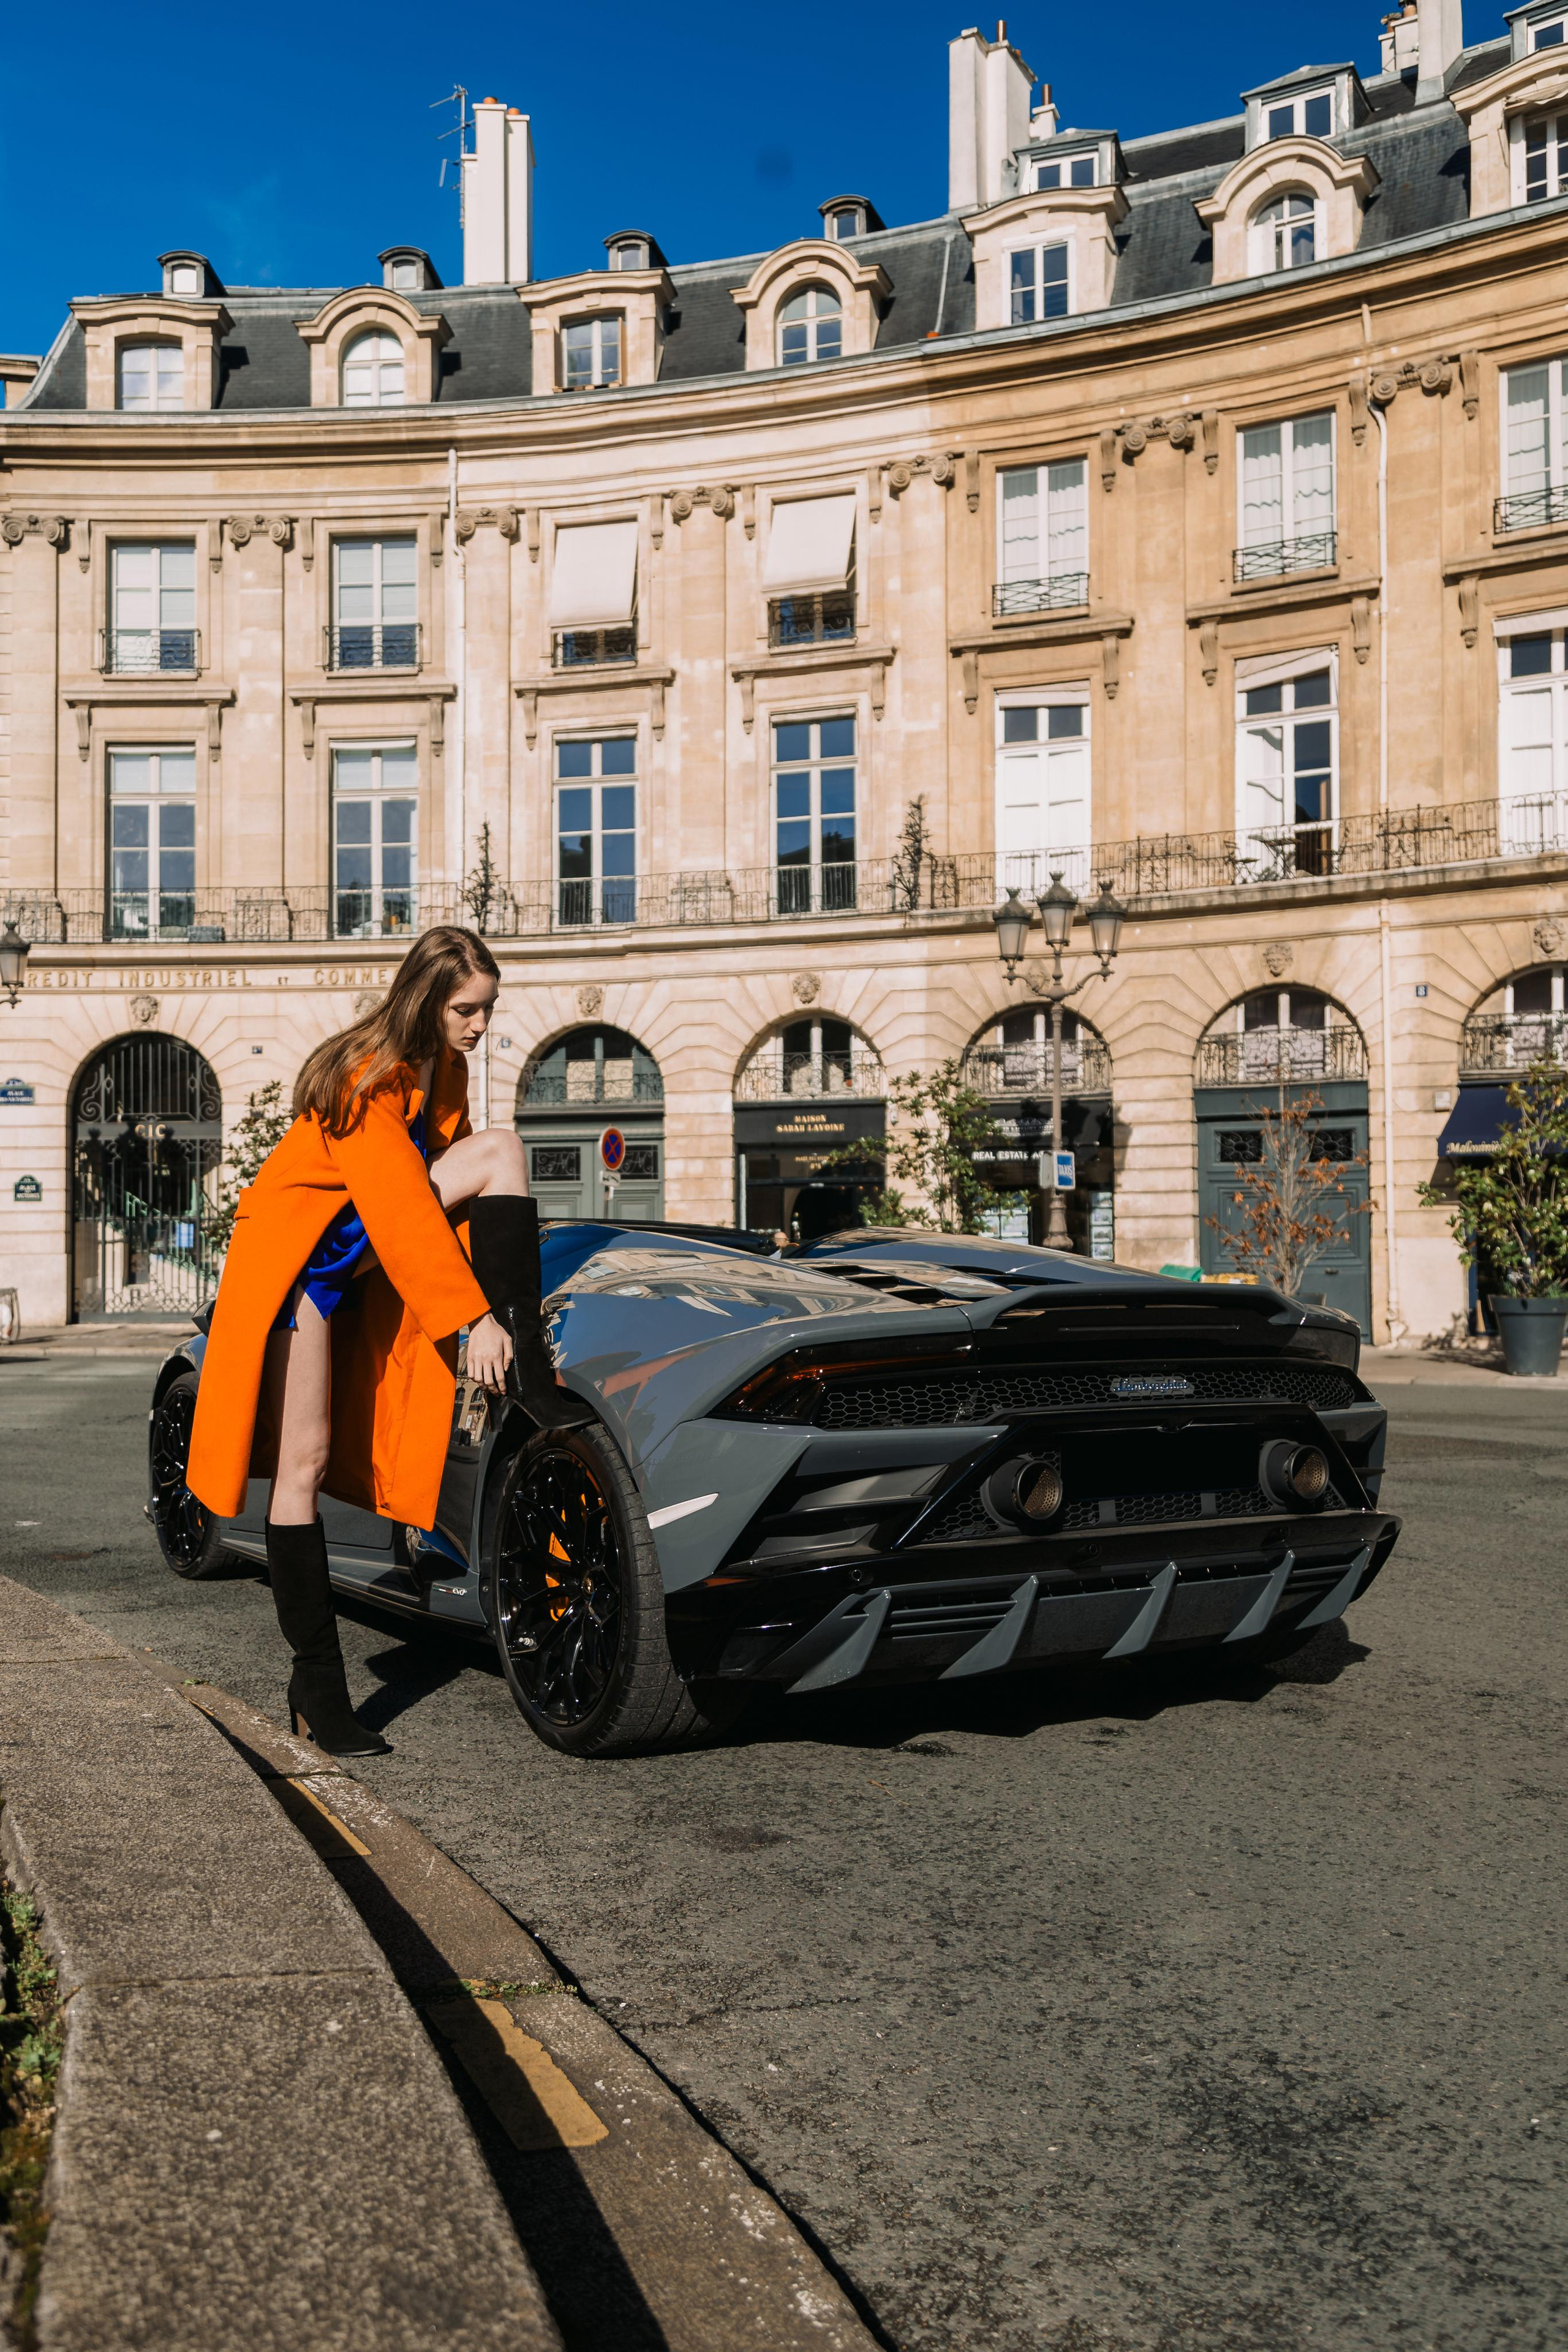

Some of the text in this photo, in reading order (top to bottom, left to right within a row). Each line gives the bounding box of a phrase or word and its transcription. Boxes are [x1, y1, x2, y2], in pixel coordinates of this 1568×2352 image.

[27, 971, 92, 987] REDIT
[119, 969, 252, 987] INDUSTRIEL
[314, 967, 398, 984] COMME
[794, 1114, 826, 1123] MAISON
[135, 1124, 166, 1139] CIC
[776, 1123, 845, 1133] SARAH LAVOINE
[972, 1152, 995, 1161] REAL
[997, 1151, 1029, 1161] ESTATE
[1058, 1164, 1072, 1178] TAXIS
[1114, 1378, 1188, 1396] Lamborghini
